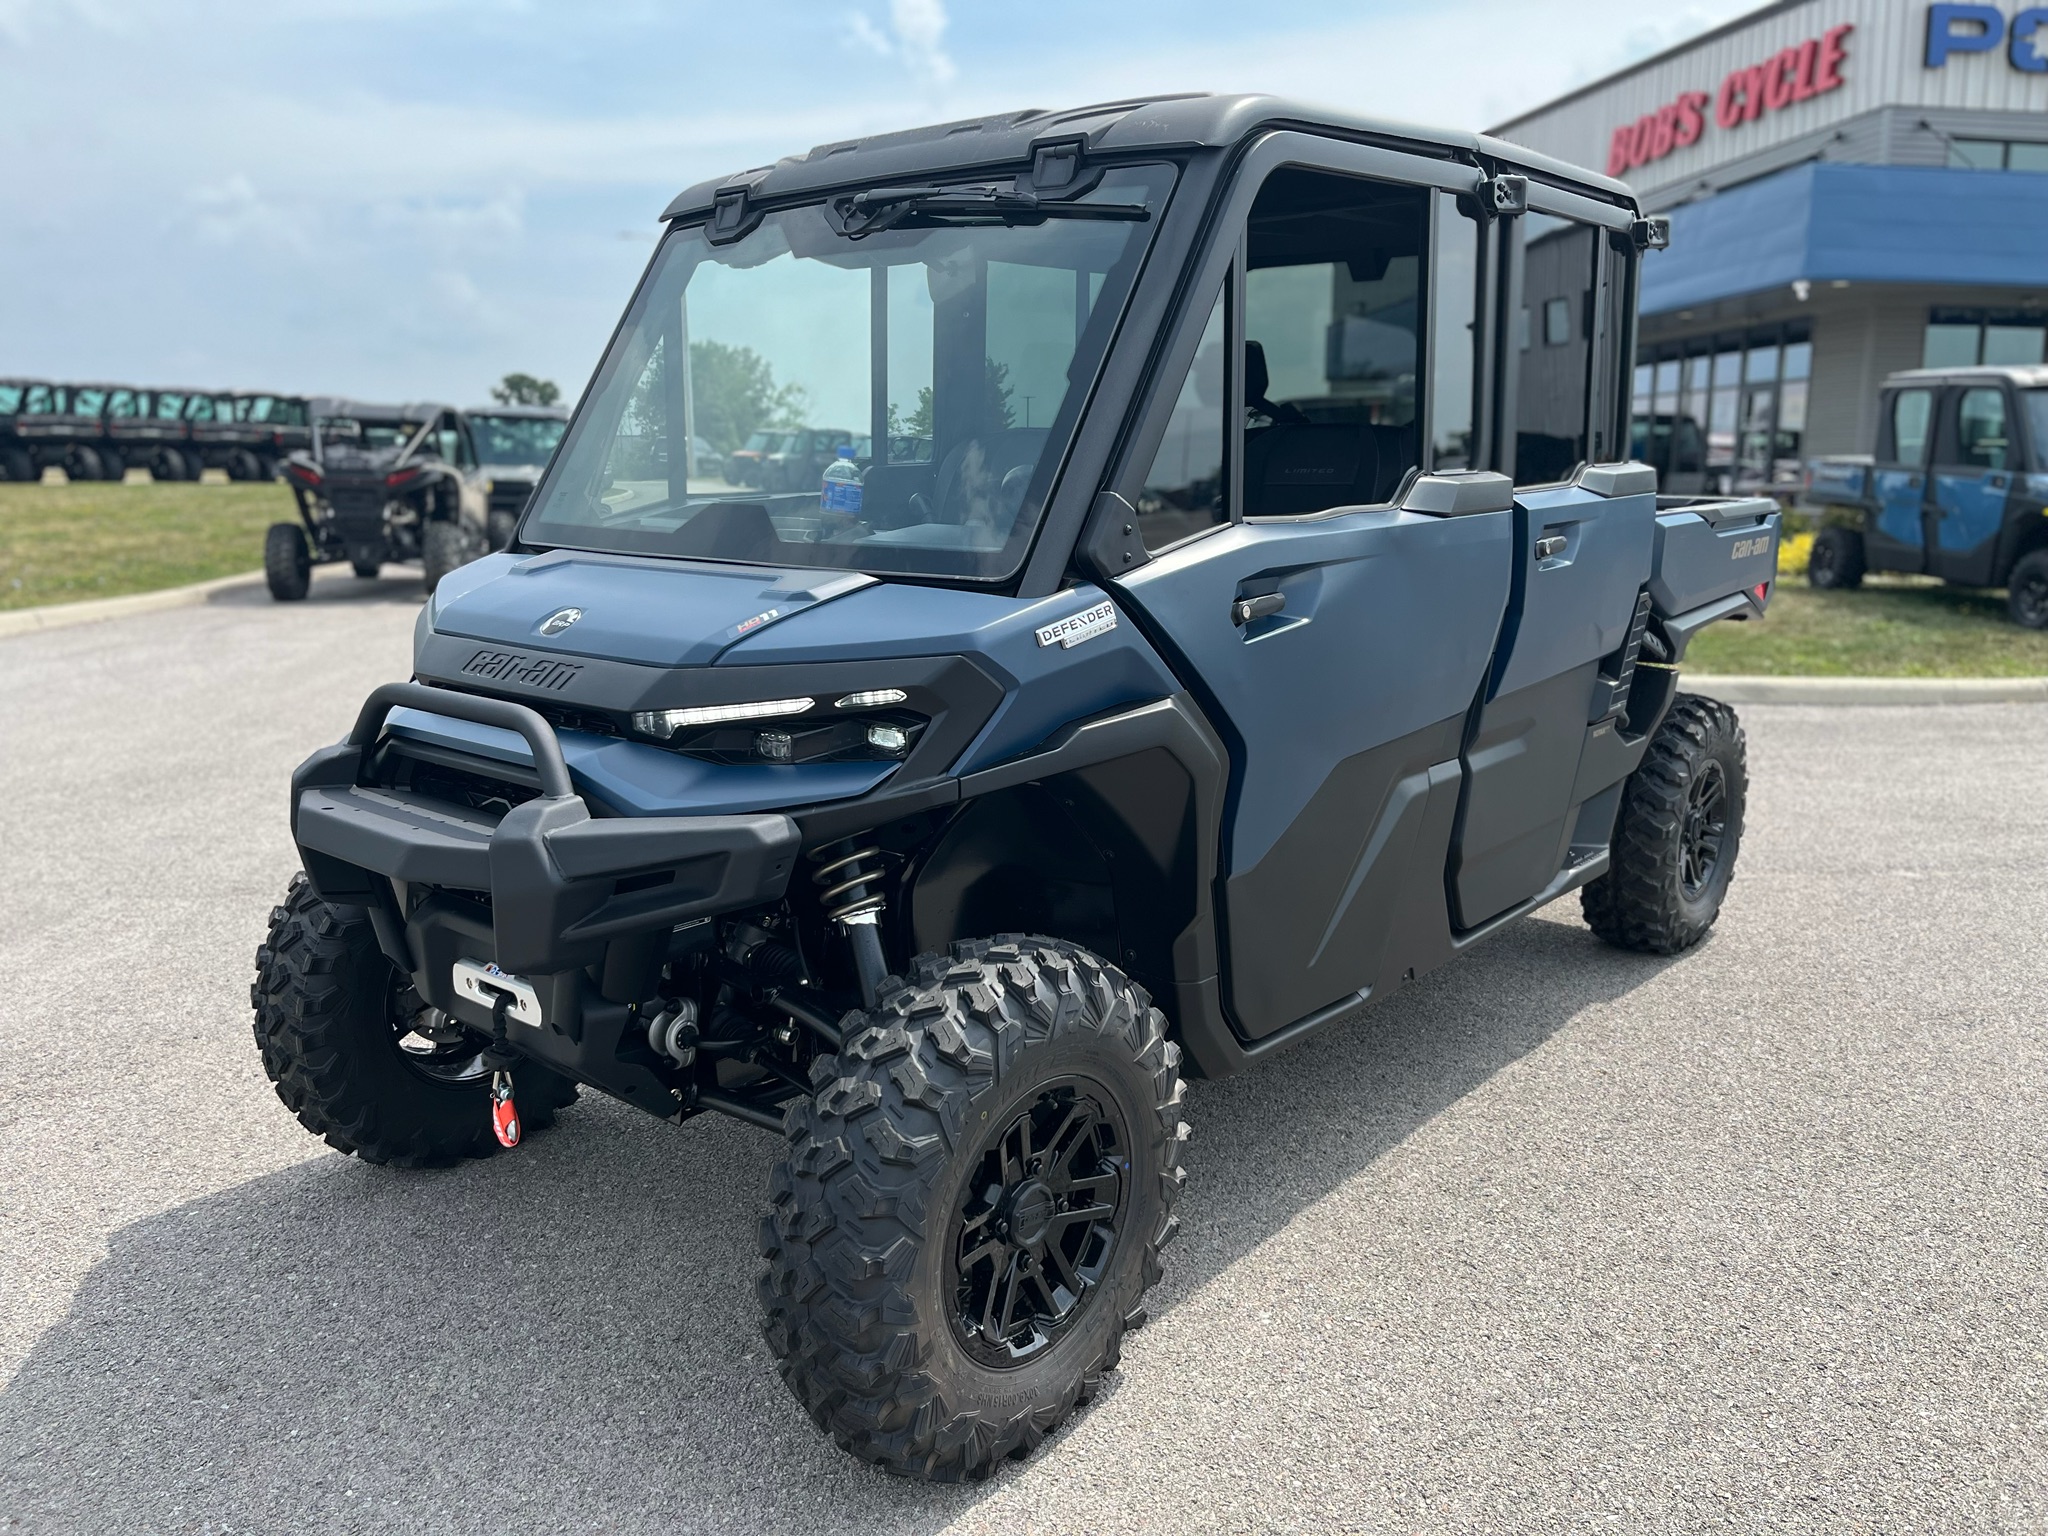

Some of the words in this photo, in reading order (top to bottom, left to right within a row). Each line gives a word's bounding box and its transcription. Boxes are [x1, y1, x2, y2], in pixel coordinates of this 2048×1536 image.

[1715, 23, 1854, 129] CYCLE
[1731, 535, 1770, 560] can-am
[551, 619, 571, 628] BRP
[1042, 604, 1114, 642] DEFENDER
[461, 650, 584, 692] can-am
